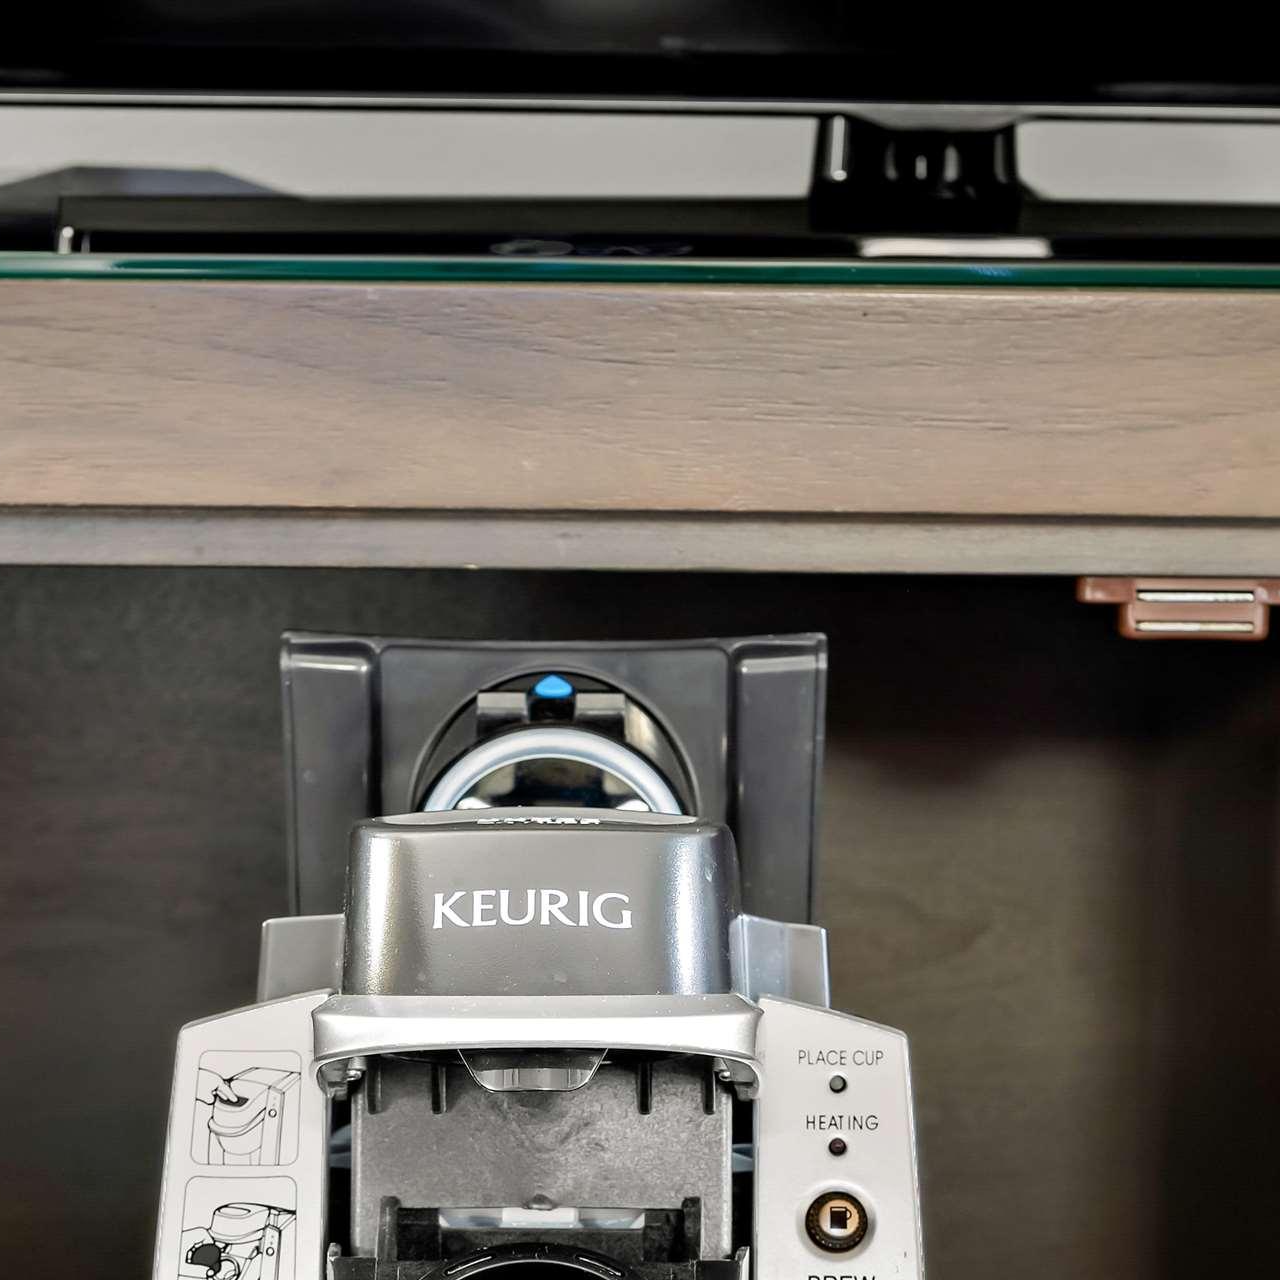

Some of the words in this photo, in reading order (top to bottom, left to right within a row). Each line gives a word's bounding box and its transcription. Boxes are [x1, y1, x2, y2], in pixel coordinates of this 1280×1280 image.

[432, 890, 633, 929] KEURIG
[798, 1050, 847, 1066] PLACE
[852, 1050, 884, 1066] CUP
[806, 1115, 879, 1131] HEATING
